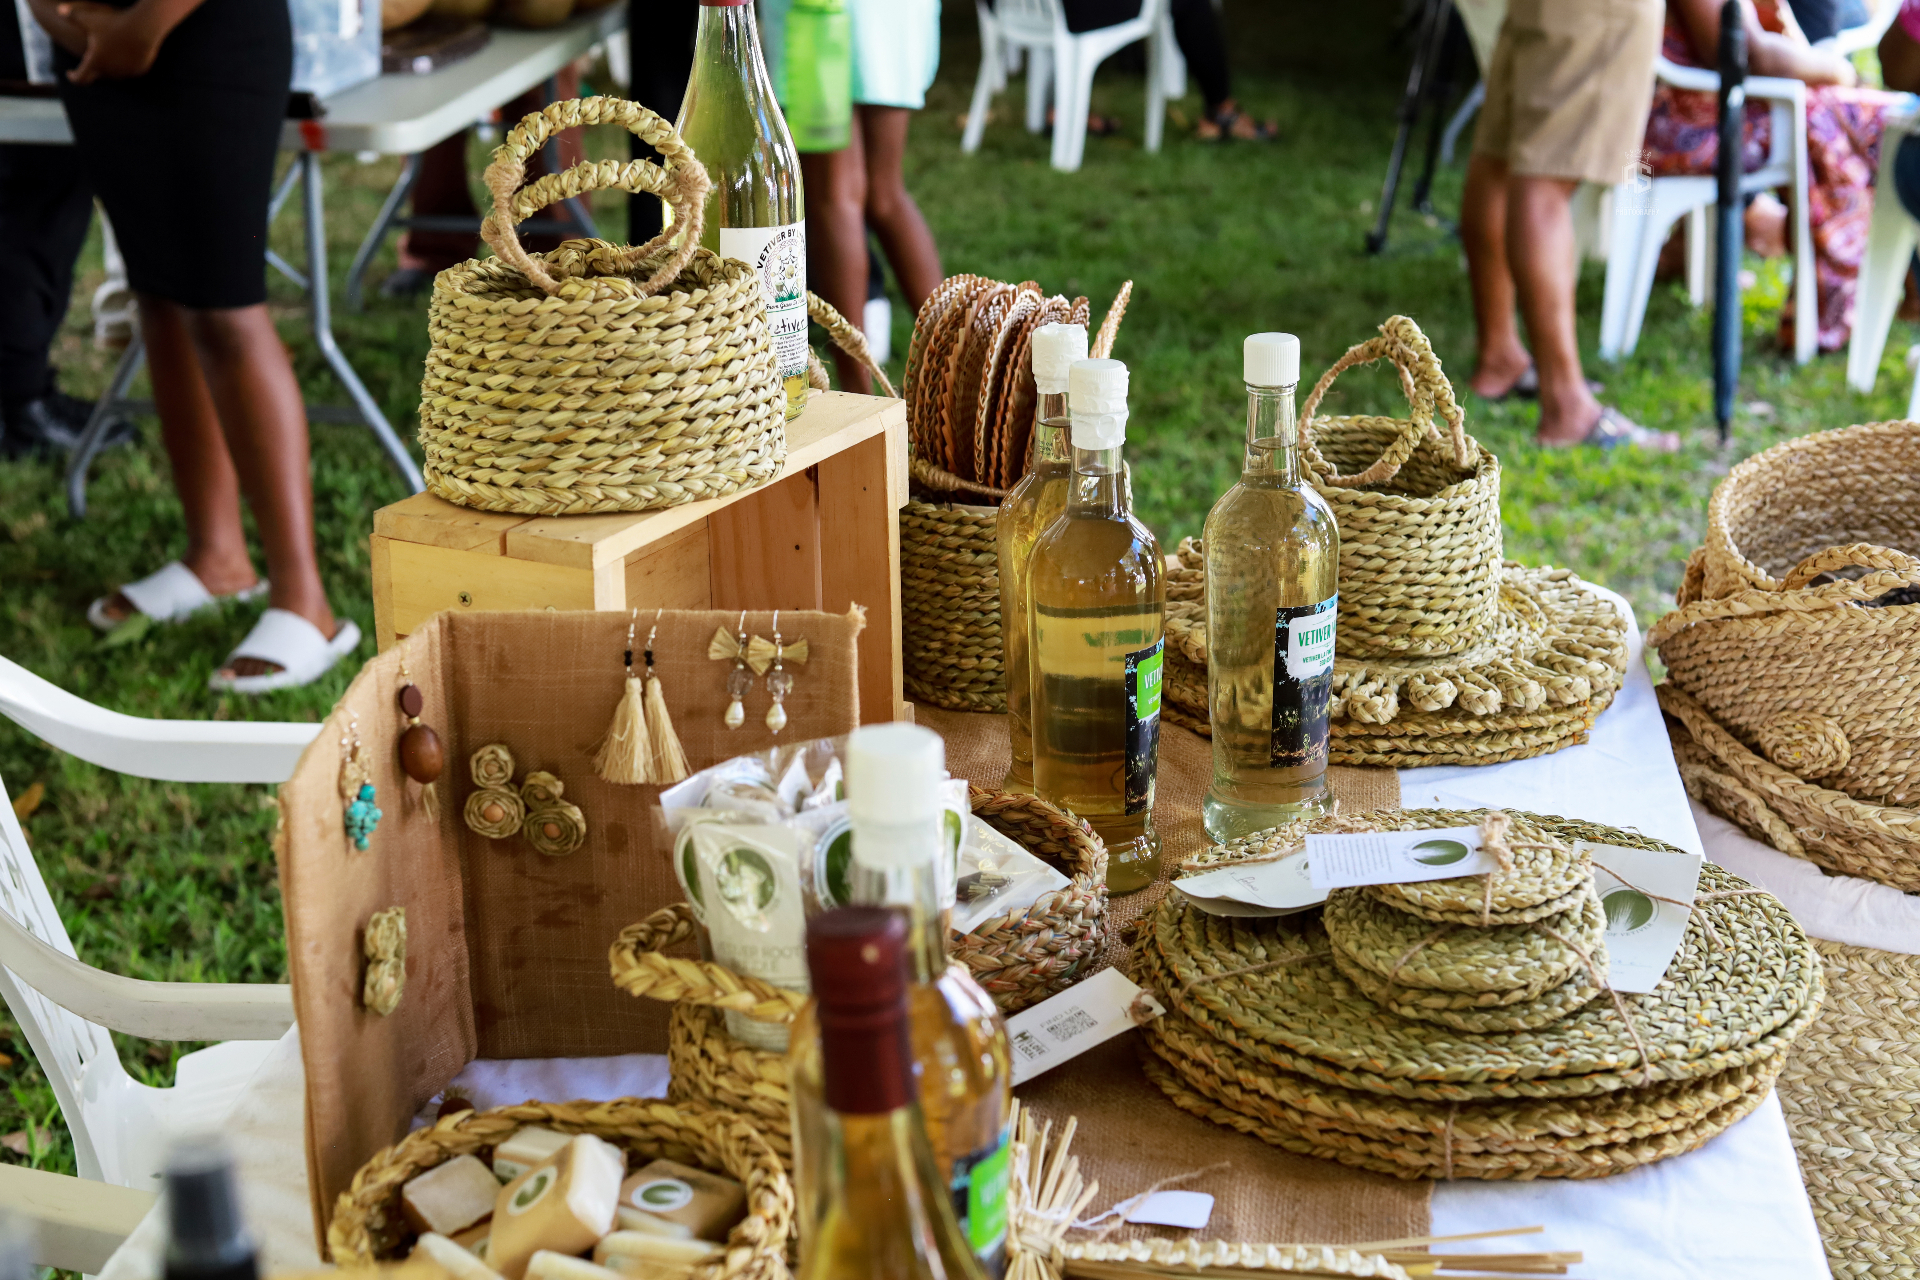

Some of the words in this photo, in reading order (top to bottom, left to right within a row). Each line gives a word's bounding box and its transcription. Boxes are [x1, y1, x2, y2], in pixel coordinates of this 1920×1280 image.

[757, 231, 786, 269] VETIVER
[788, 229, 796, 237] BY
[1298, 624, 1331, 647] VETIVER
[1620, 923, 1653, 937] VETIVER
[1040, 1013, 1063, 1028] FIND
